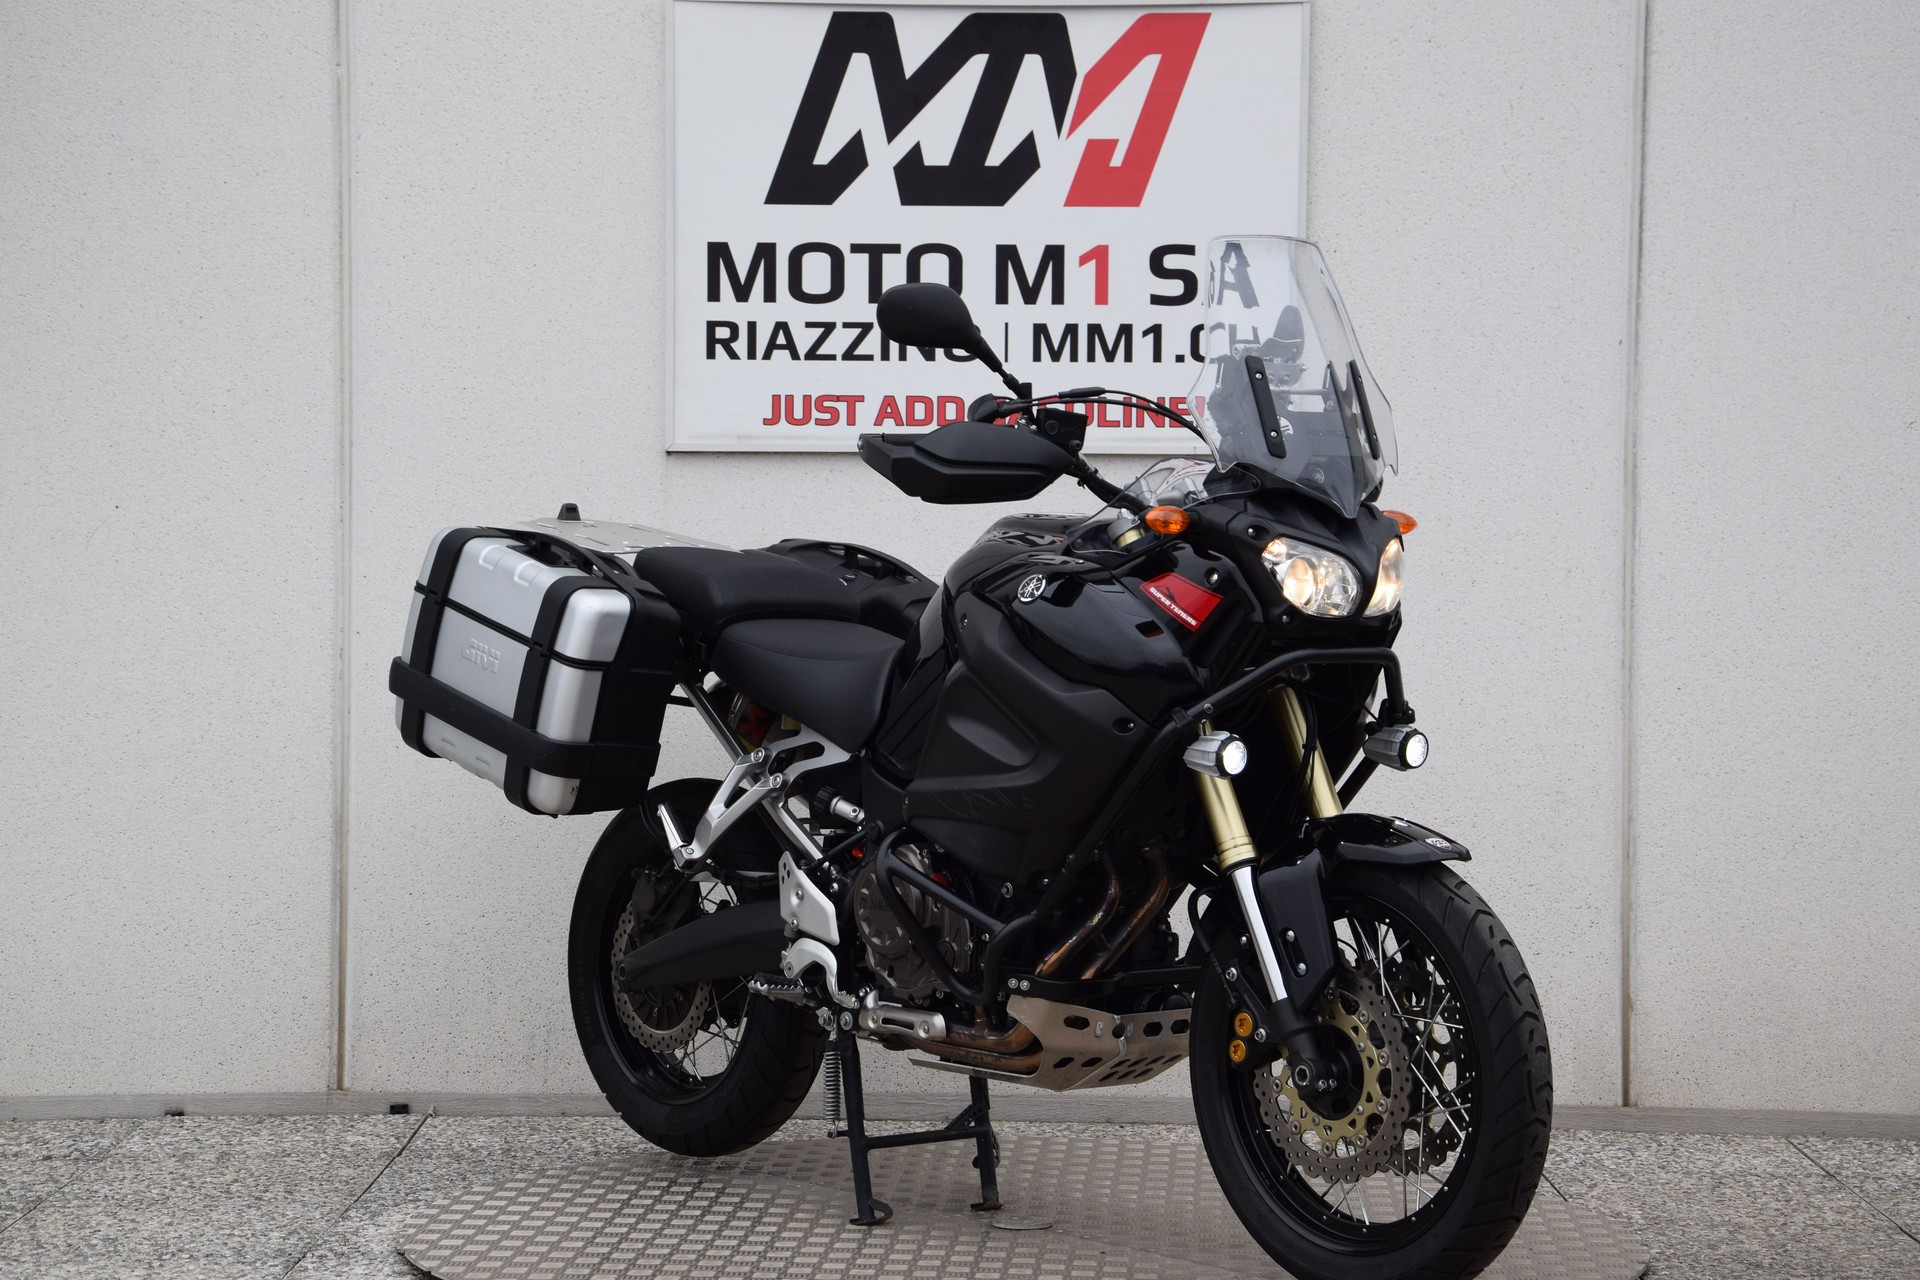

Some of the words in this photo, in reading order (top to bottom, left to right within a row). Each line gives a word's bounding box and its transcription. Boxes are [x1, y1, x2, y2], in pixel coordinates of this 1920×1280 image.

[707, 242, 963, 305] MOTO
[996, 244, 1109, 306] M1
[1149, 243, 1260, 309] SA
[763, 394, 864, 427] JUST
[875, 395, 965, 427] ADD
[1149, 587, 1171, 606] SUPER
[461, 638, 502, 674] GIVI
